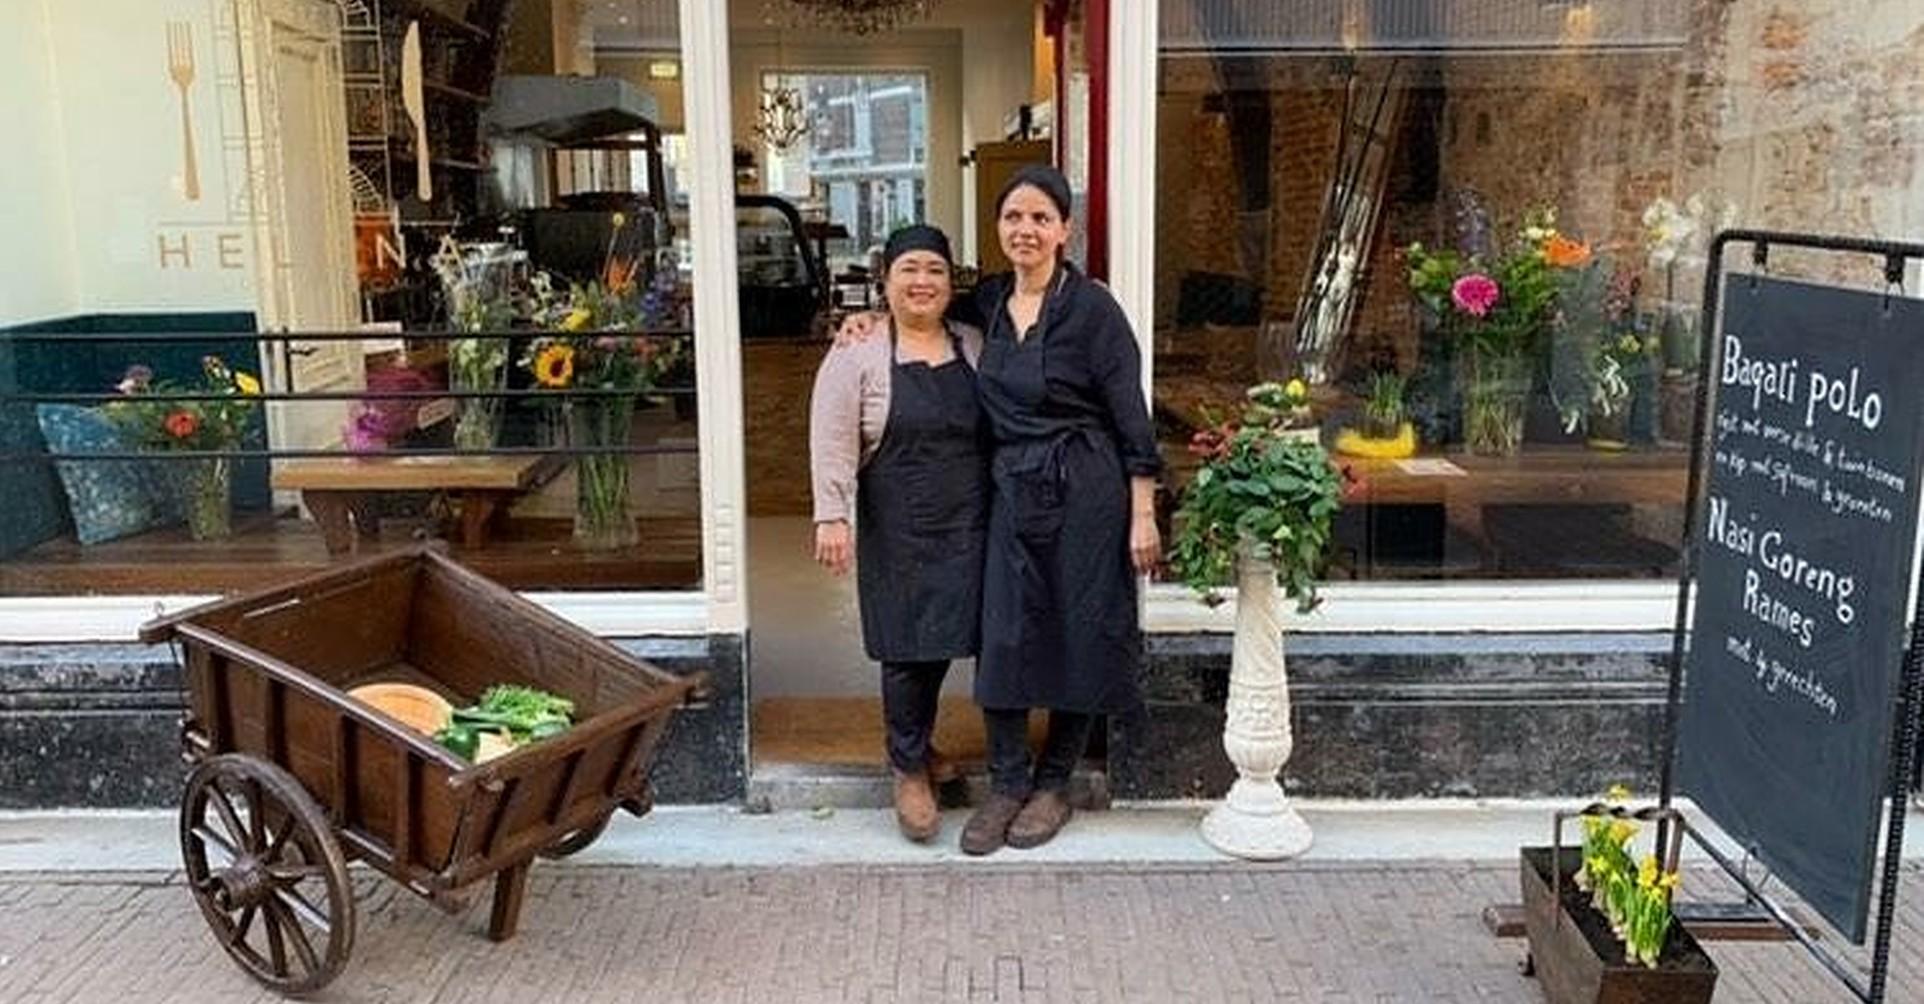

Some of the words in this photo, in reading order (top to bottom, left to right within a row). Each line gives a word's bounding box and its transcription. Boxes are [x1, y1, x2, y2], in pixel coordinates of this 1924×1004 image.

[158, 234, 466, 269] HELNA
[1708, 496, 1757, 555] Nasi
[1760, 531, 1854, 624] Goreng
[1743, 569, 1814, 648] Rames
